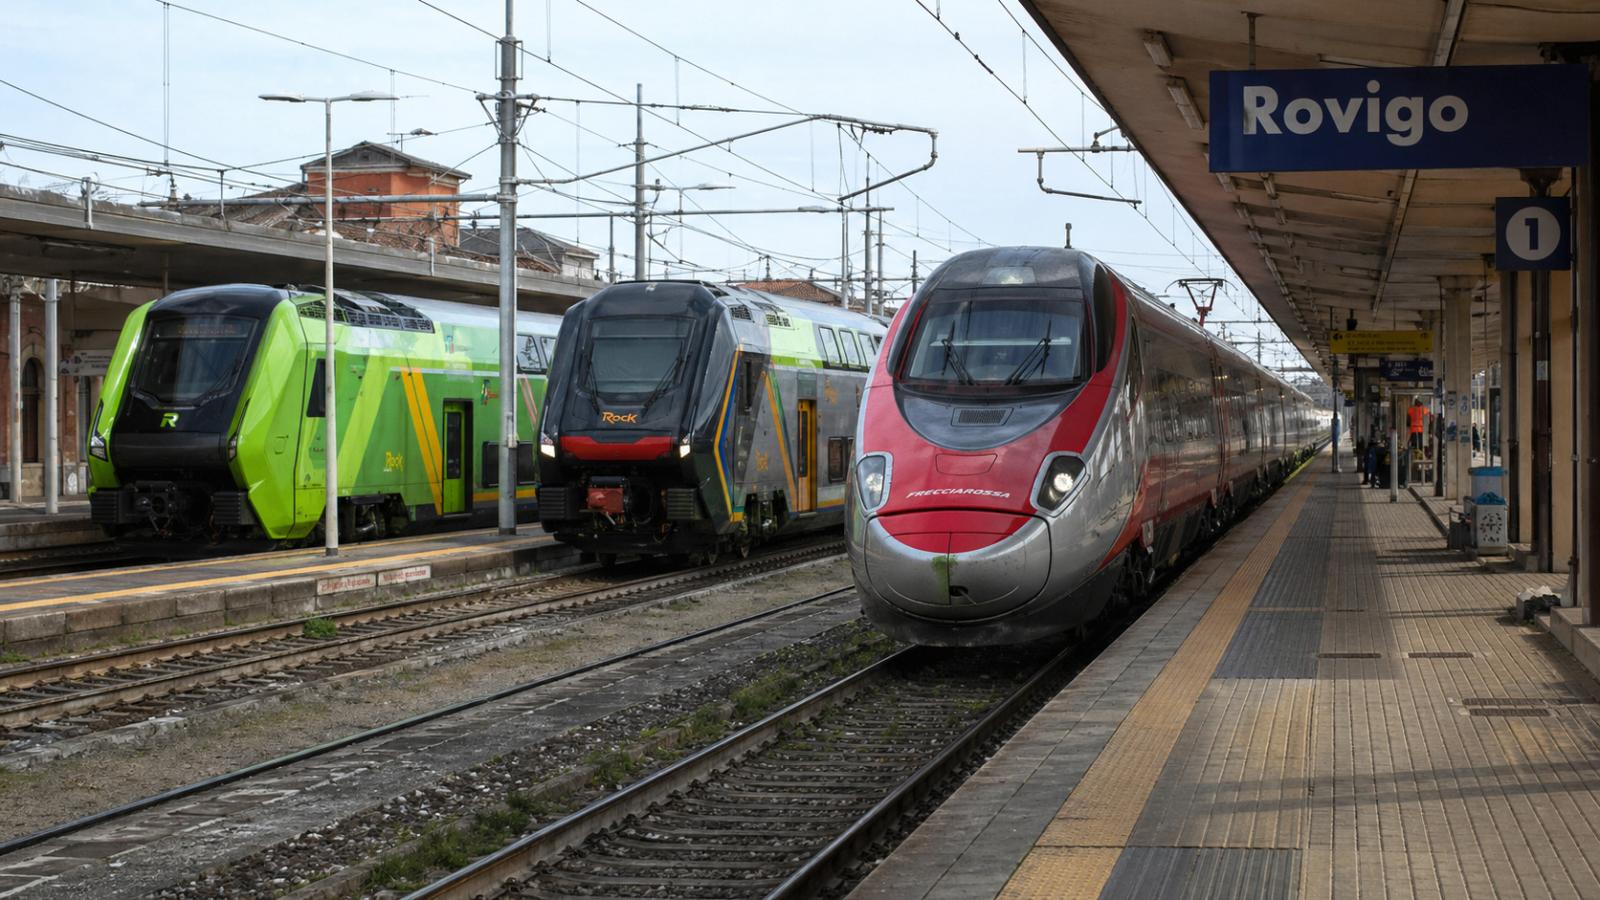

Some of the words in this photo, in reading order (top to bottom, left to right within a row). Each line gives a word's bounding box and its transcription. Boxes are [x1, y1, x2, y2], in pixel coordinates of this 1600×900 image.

[1243, 80, 1468, 146] Rovigo
[1524, 217, 1539, 250] 1
[160, 412, 179, 428] R
[905, 488, 1010, 499] FRECCIAROSSA
